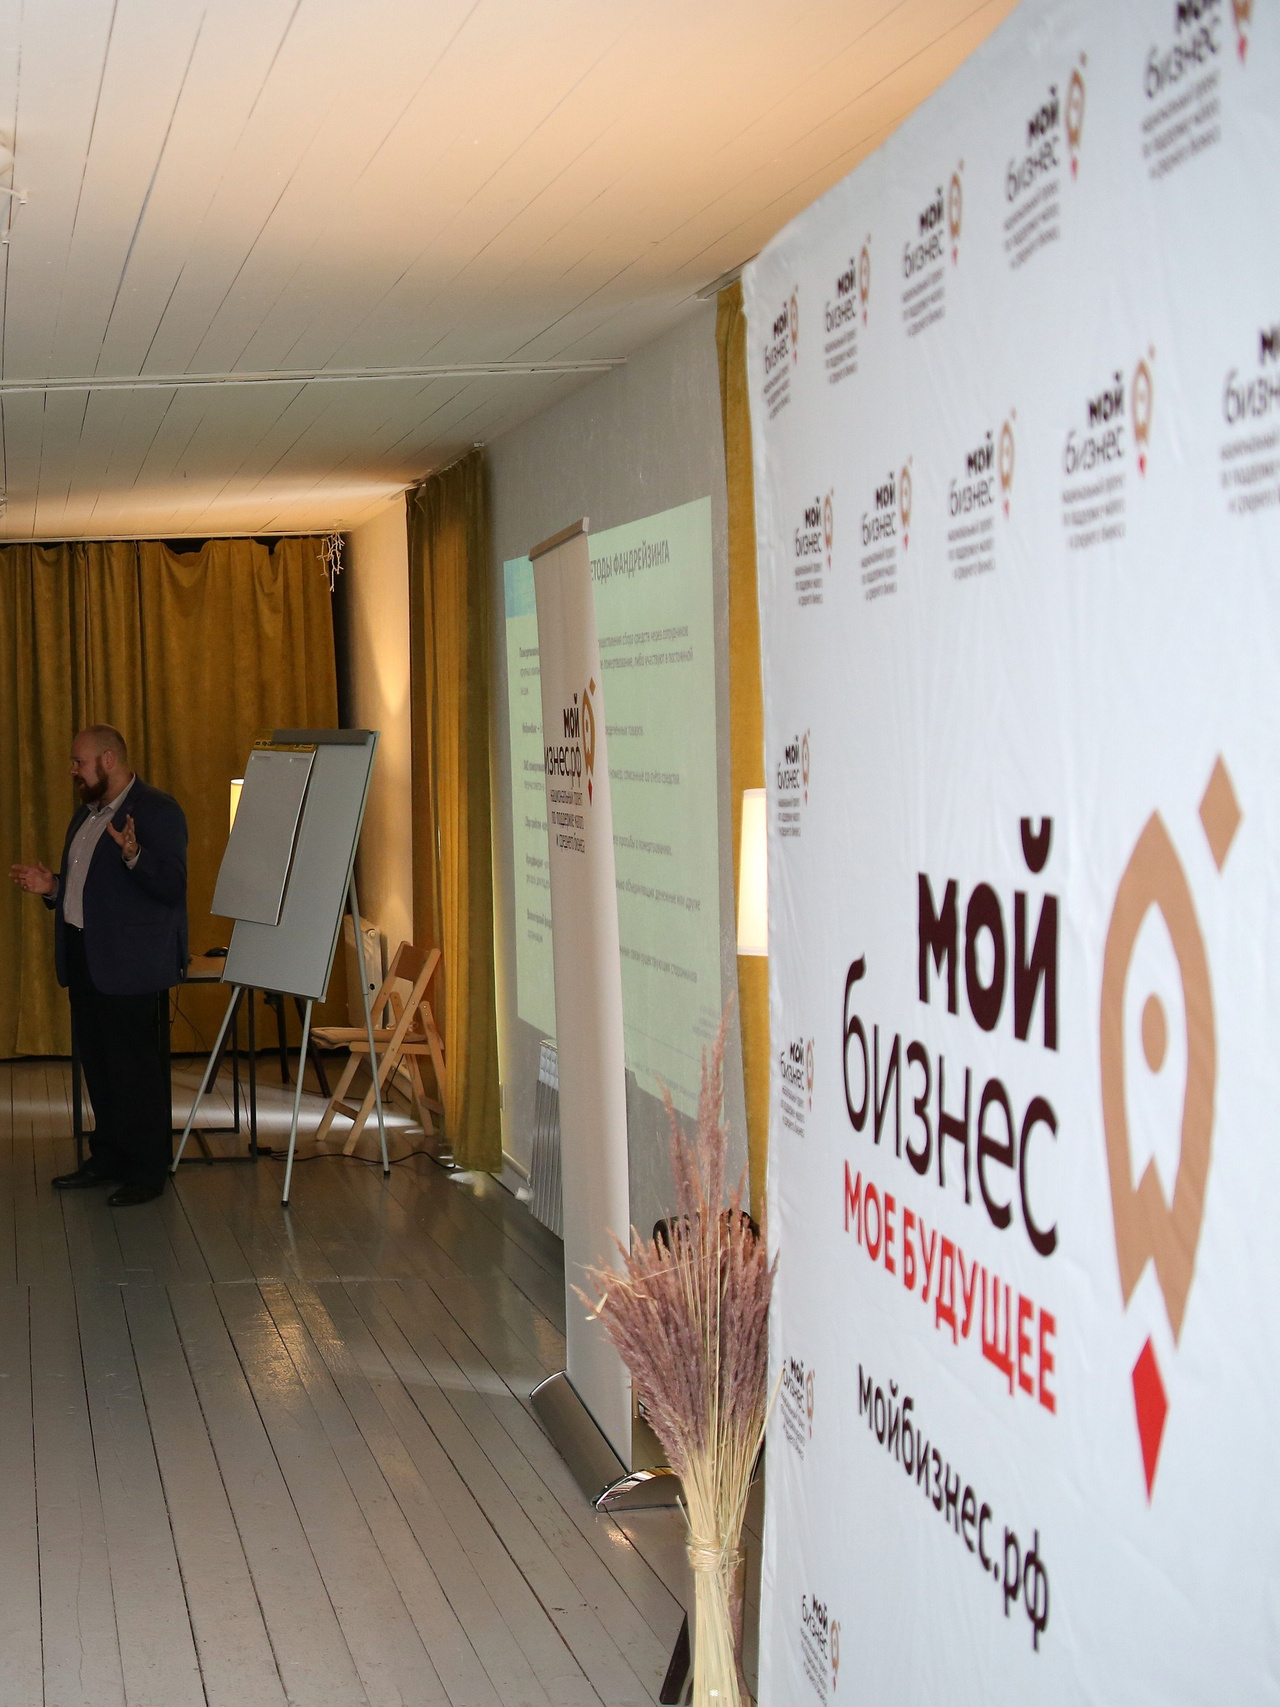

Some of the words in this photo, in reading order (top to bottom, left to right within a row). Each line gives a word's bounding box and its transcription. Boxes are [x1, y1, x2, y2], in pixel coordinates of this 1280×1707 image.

[1026, 84, 1060, 147] мой
[1006, 134, 1060, 203] бизнес
[919, 185, 945, 236] мой
[904, 229, 945, 280] бизнес
[837, 257, 857, 300] мой
[772, 302, 789, 341] мой
[825, 294, 858, 333] бизнес
[764, 333, 789, 375] бизнес
[1087, 369, 1124, 428] мой
[966, 429, 995, 478] мой
[1063, 425, 1125, 476] бизнес
[875, 471, 897, 511] мой
[949, 476, 995, 517] бизнес
[804, 496, 822, 530] мой
[861, 512, 897, 547] бизнес
[613, 539, 670, 579] ФАНДРЕЙЗИНГА
[794, 528, 823, 558] бизнес
[563, 693, 581, 738] мой
[785, 735, 800, 764] мой
[777, 762, 800, 790] бизнес
[917, 816, 1061, 1054] мой
[780, 1051, 805, 1091] бизнес
[789, 1036, 805, 1067] мой
[841, 951, 1061, 1258] бизнес
[844, 1159, 897, 1276] МОЕ
[901, 1204, 1058, 1417] БУДУЩЕЕ
[857, 1362, 1051, 1653] мойбизнес.рф
